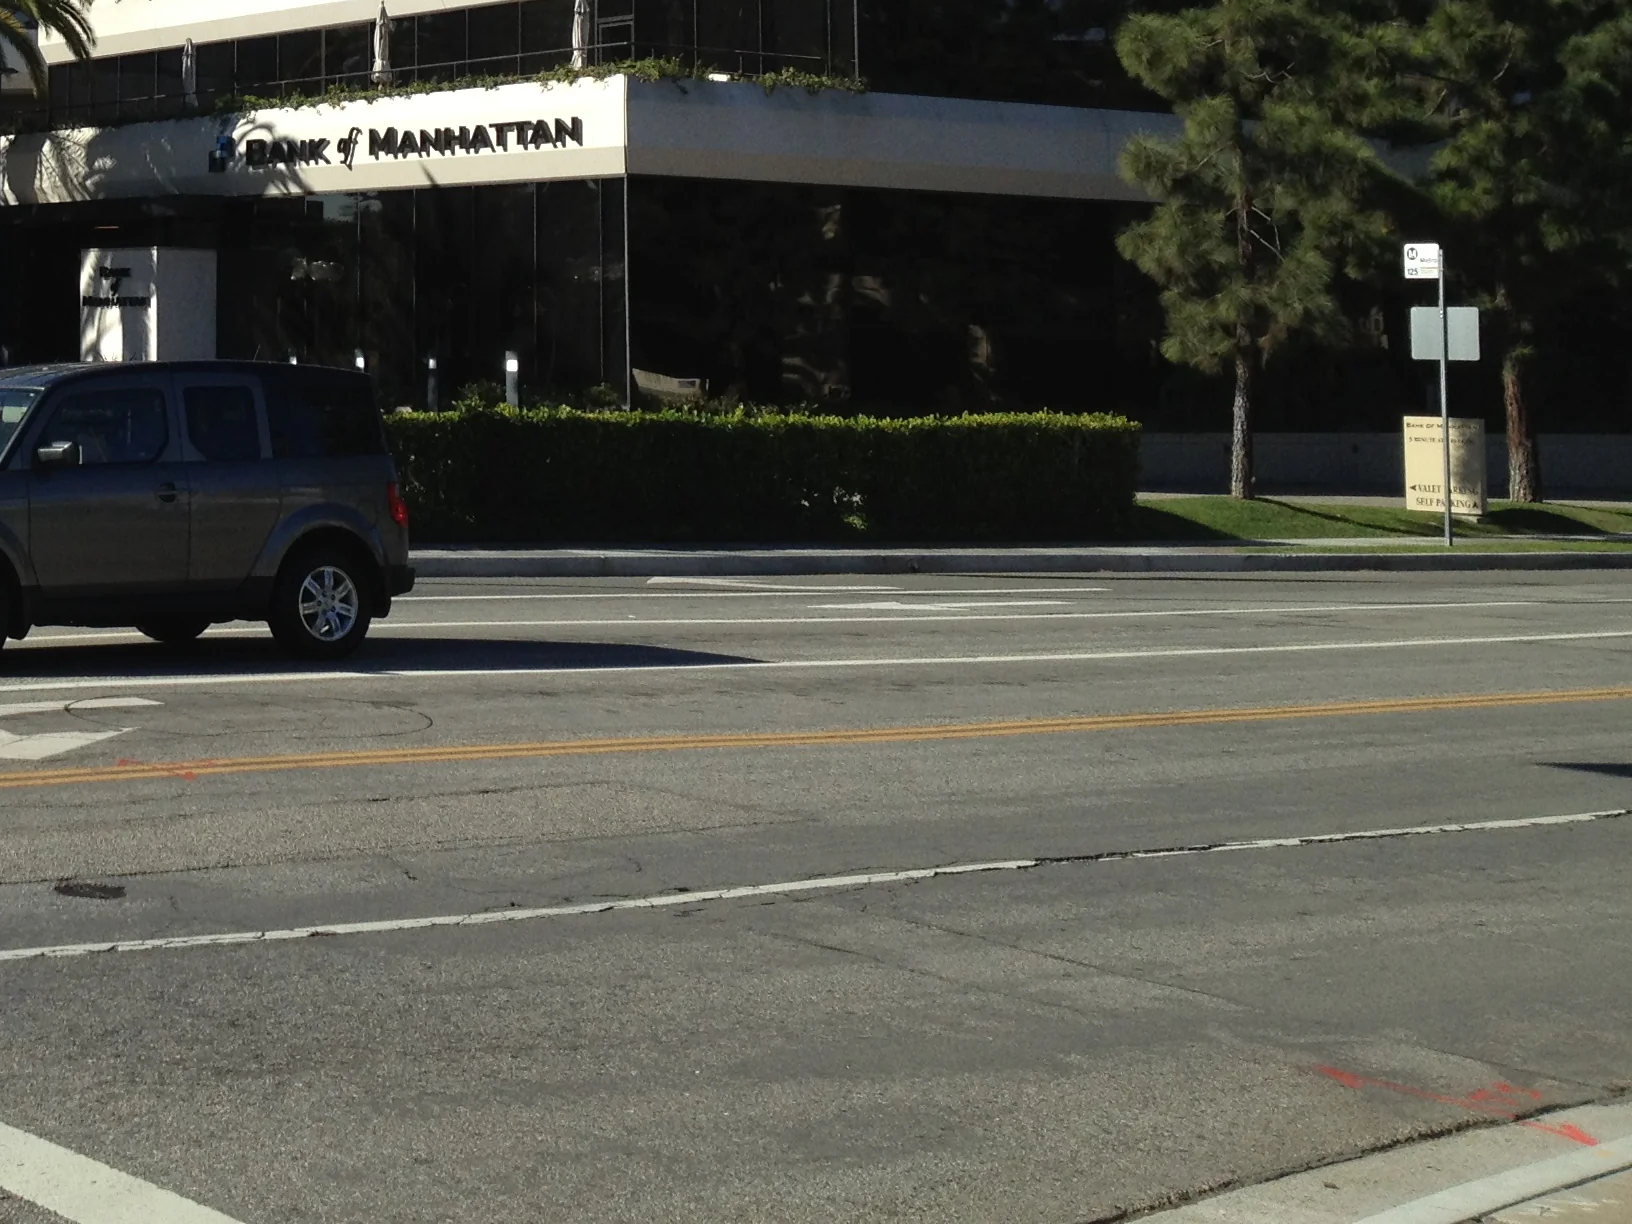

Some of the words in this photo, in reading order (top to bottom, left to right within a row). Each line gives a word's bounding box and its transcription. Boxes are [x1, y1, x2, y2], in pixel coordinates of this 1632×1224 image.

[245, 137, 330, 169] BANK
[337, 127, 363, 170] of
[368, 116, 583, 160] MANHATTAN
[1407, 268, 1418, 276] 125
[1418, 484, 1441, 493] VALET
[1416, 497, 1434, 507] SELF
[1436, 498, 1471, 509] PAKING
